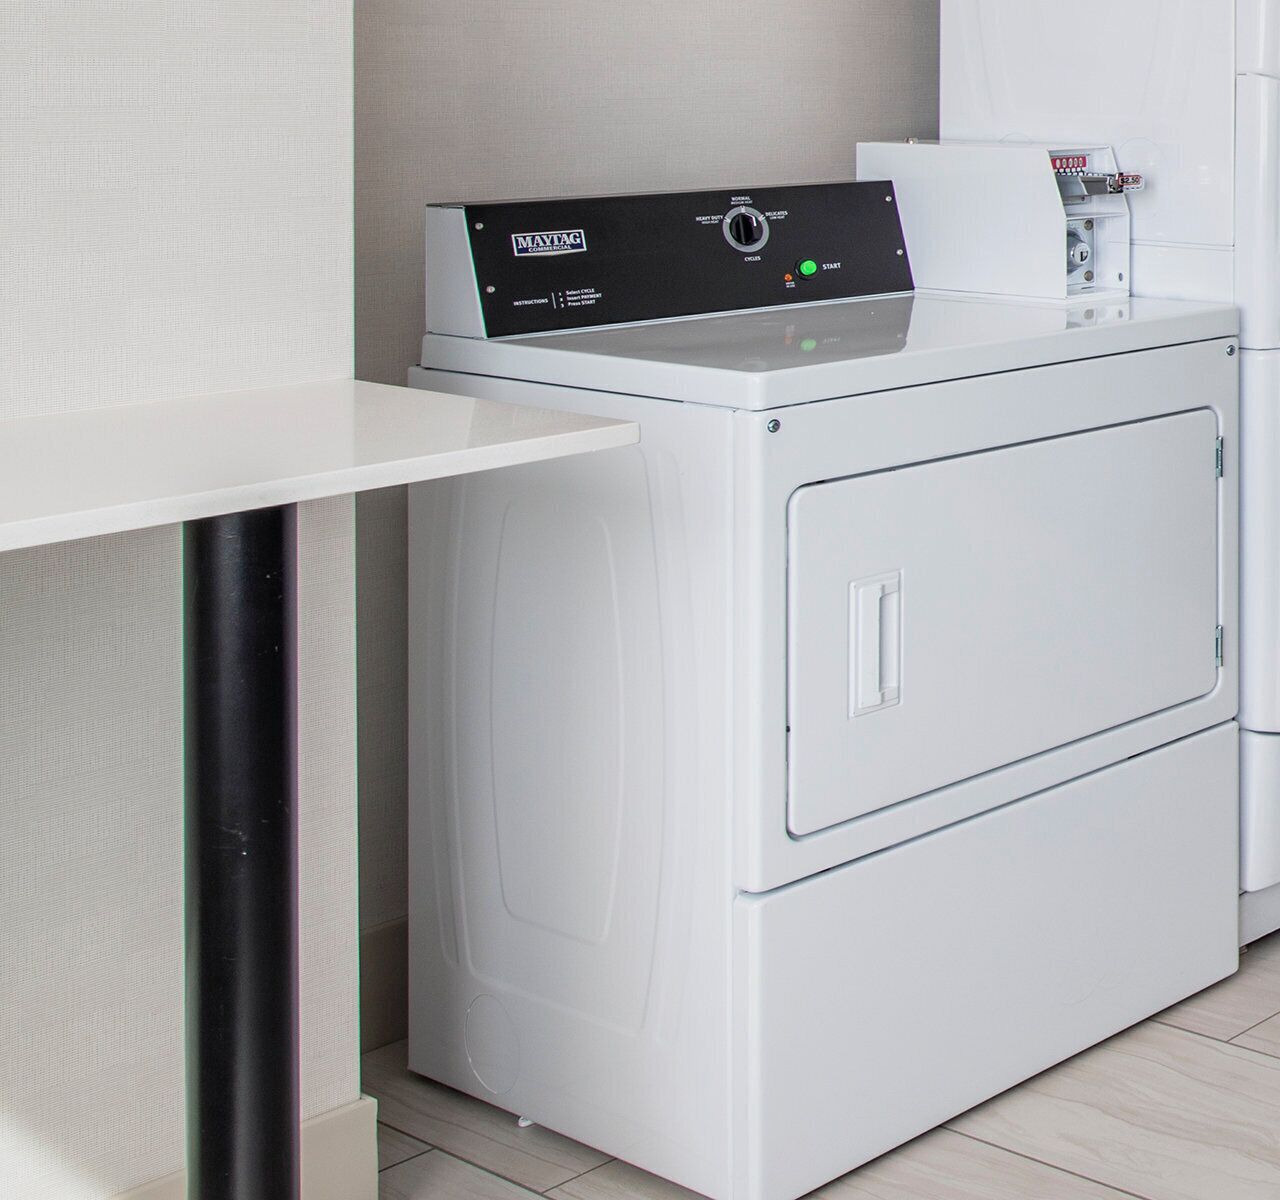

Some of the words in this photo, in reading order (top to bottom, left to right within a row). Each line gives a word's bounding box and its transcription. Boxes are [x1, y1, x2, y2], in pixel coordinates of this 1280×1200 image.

[516, 232, 581, 249] MAYTAG
[528, 244, 572, 253] COMMERCIAL
[822, 262, 841, 270] START
[513, 298, 549, 306] INSTRUCTIONS
